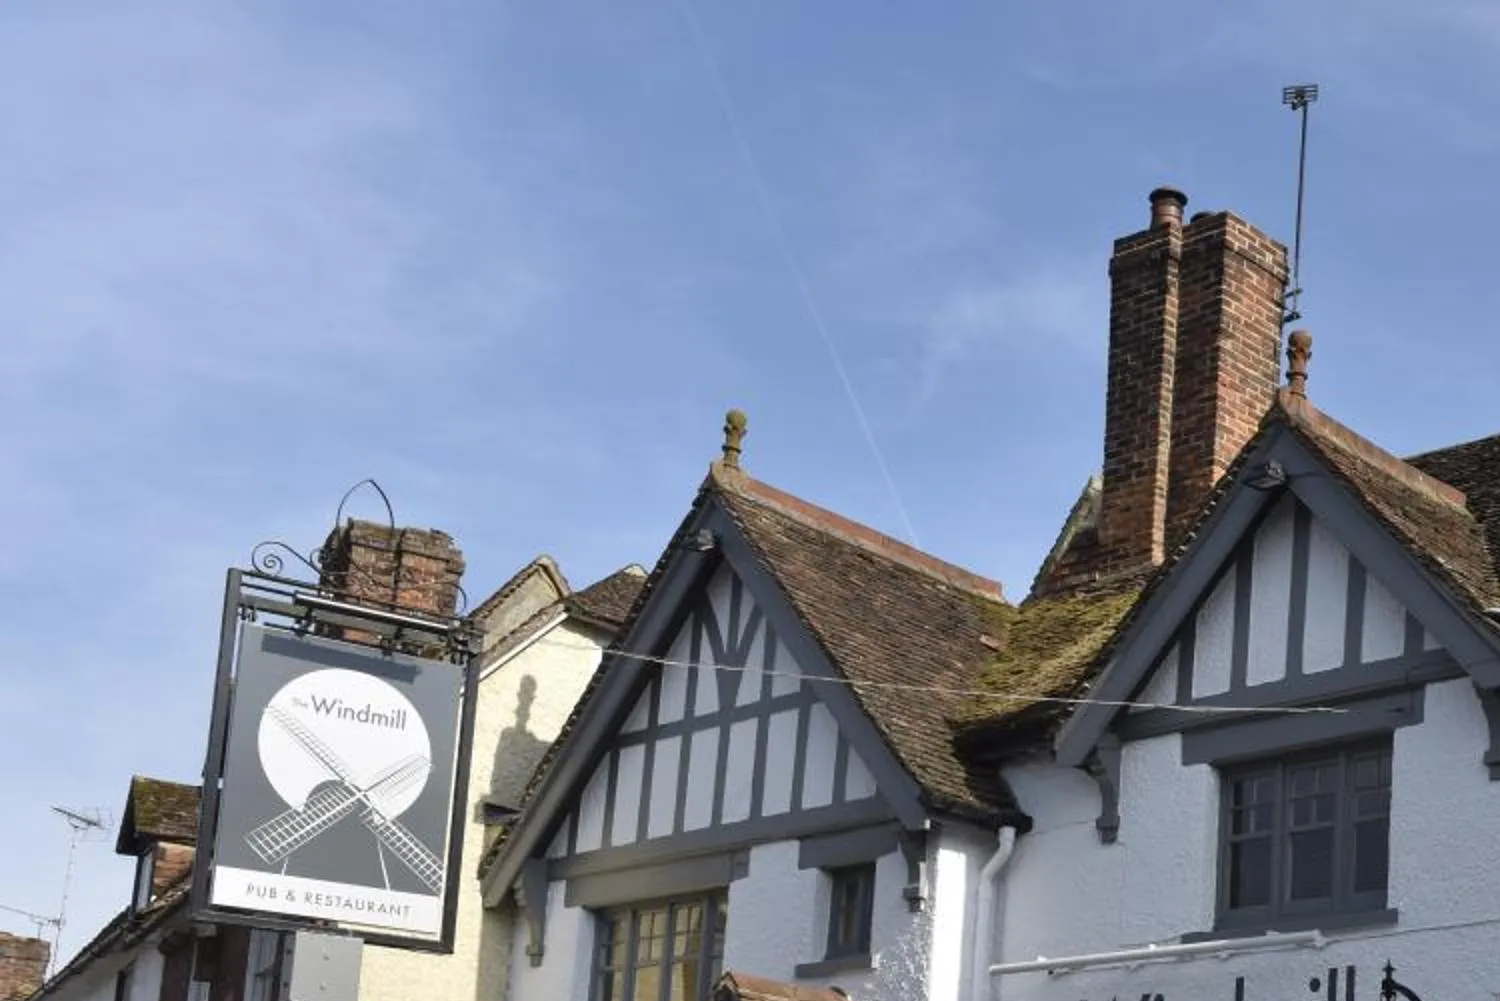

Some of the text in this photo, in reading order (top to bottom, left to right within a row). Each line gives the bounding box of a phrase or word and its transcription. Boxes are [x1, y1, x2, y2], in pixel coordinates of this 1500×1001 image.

[311, 693, 407, 731] Windmill
[247, 883, 411, 917] PUB & RESTAURANT
